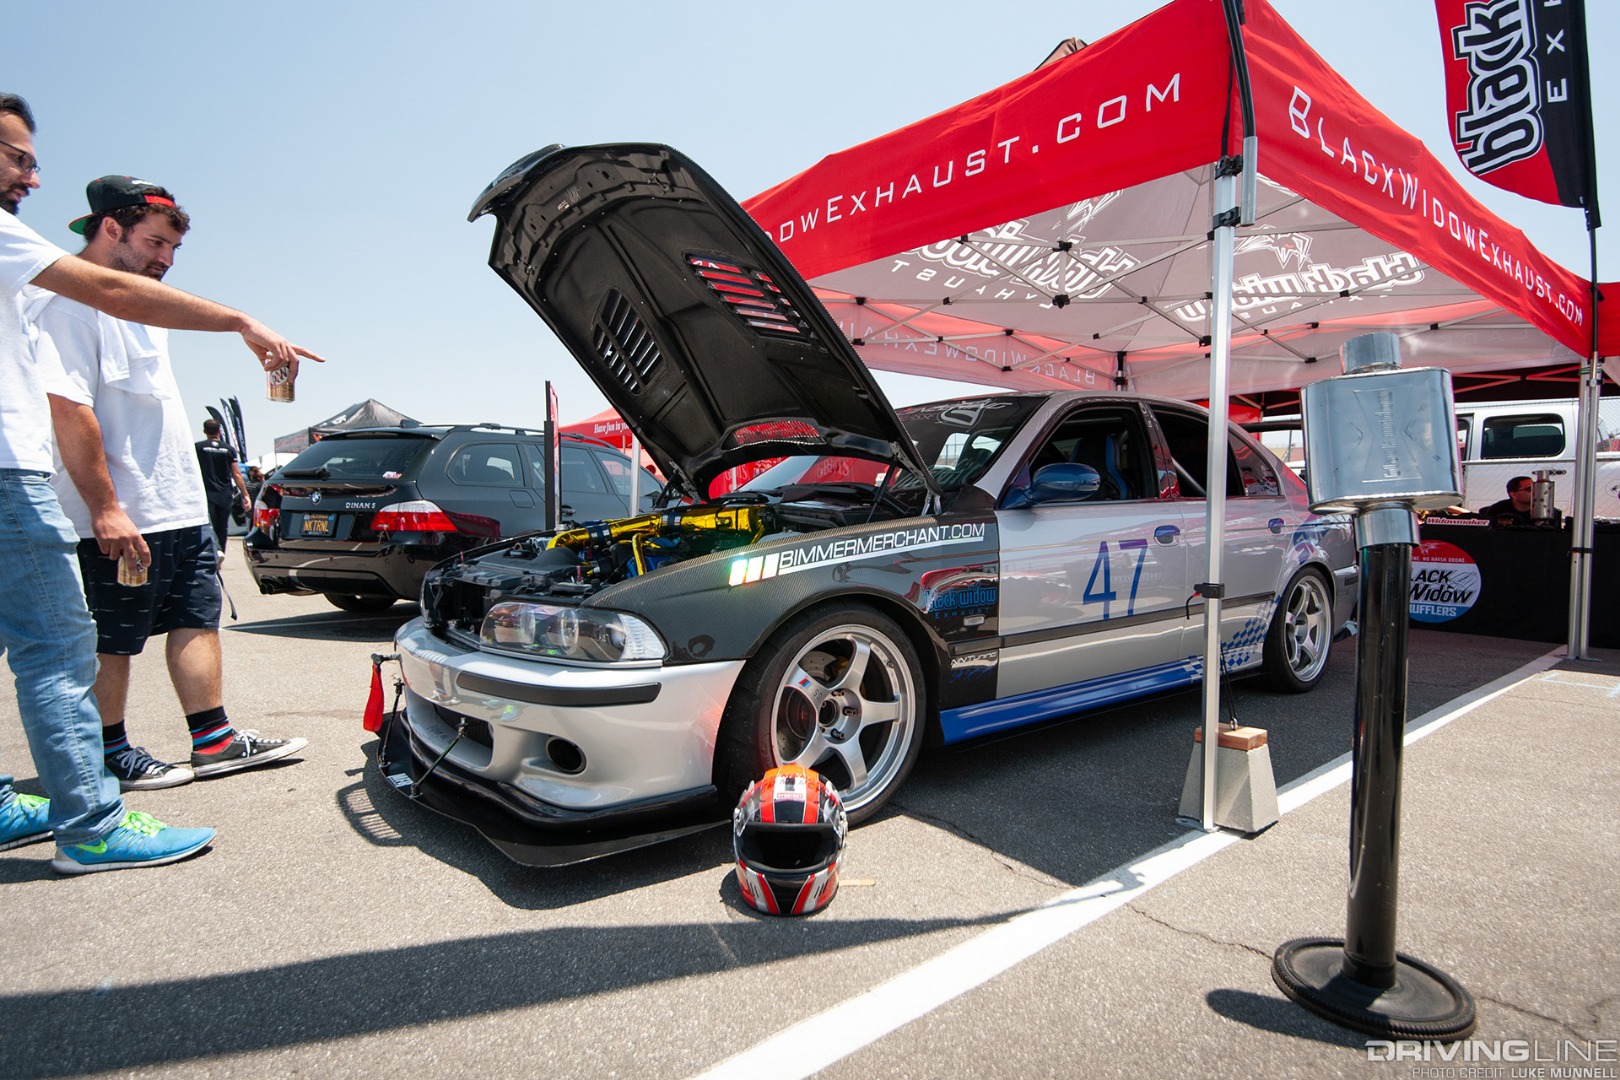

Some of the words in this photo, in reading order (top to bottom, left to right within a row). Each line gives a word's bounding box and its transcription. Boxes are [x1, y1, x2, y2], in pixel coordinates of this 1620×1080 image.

[1544, 0, 1569, 104] EX
[766, 72, 1181, 243] OWEXHAUST.COM
[779, 522, 985, 569] BIMMERMERCHANT.COM
[1411, 569, 1455, 583] ACK
[1083, 538, 1148, 620] 47
[935, 606, 989, 619] EXHAUST
